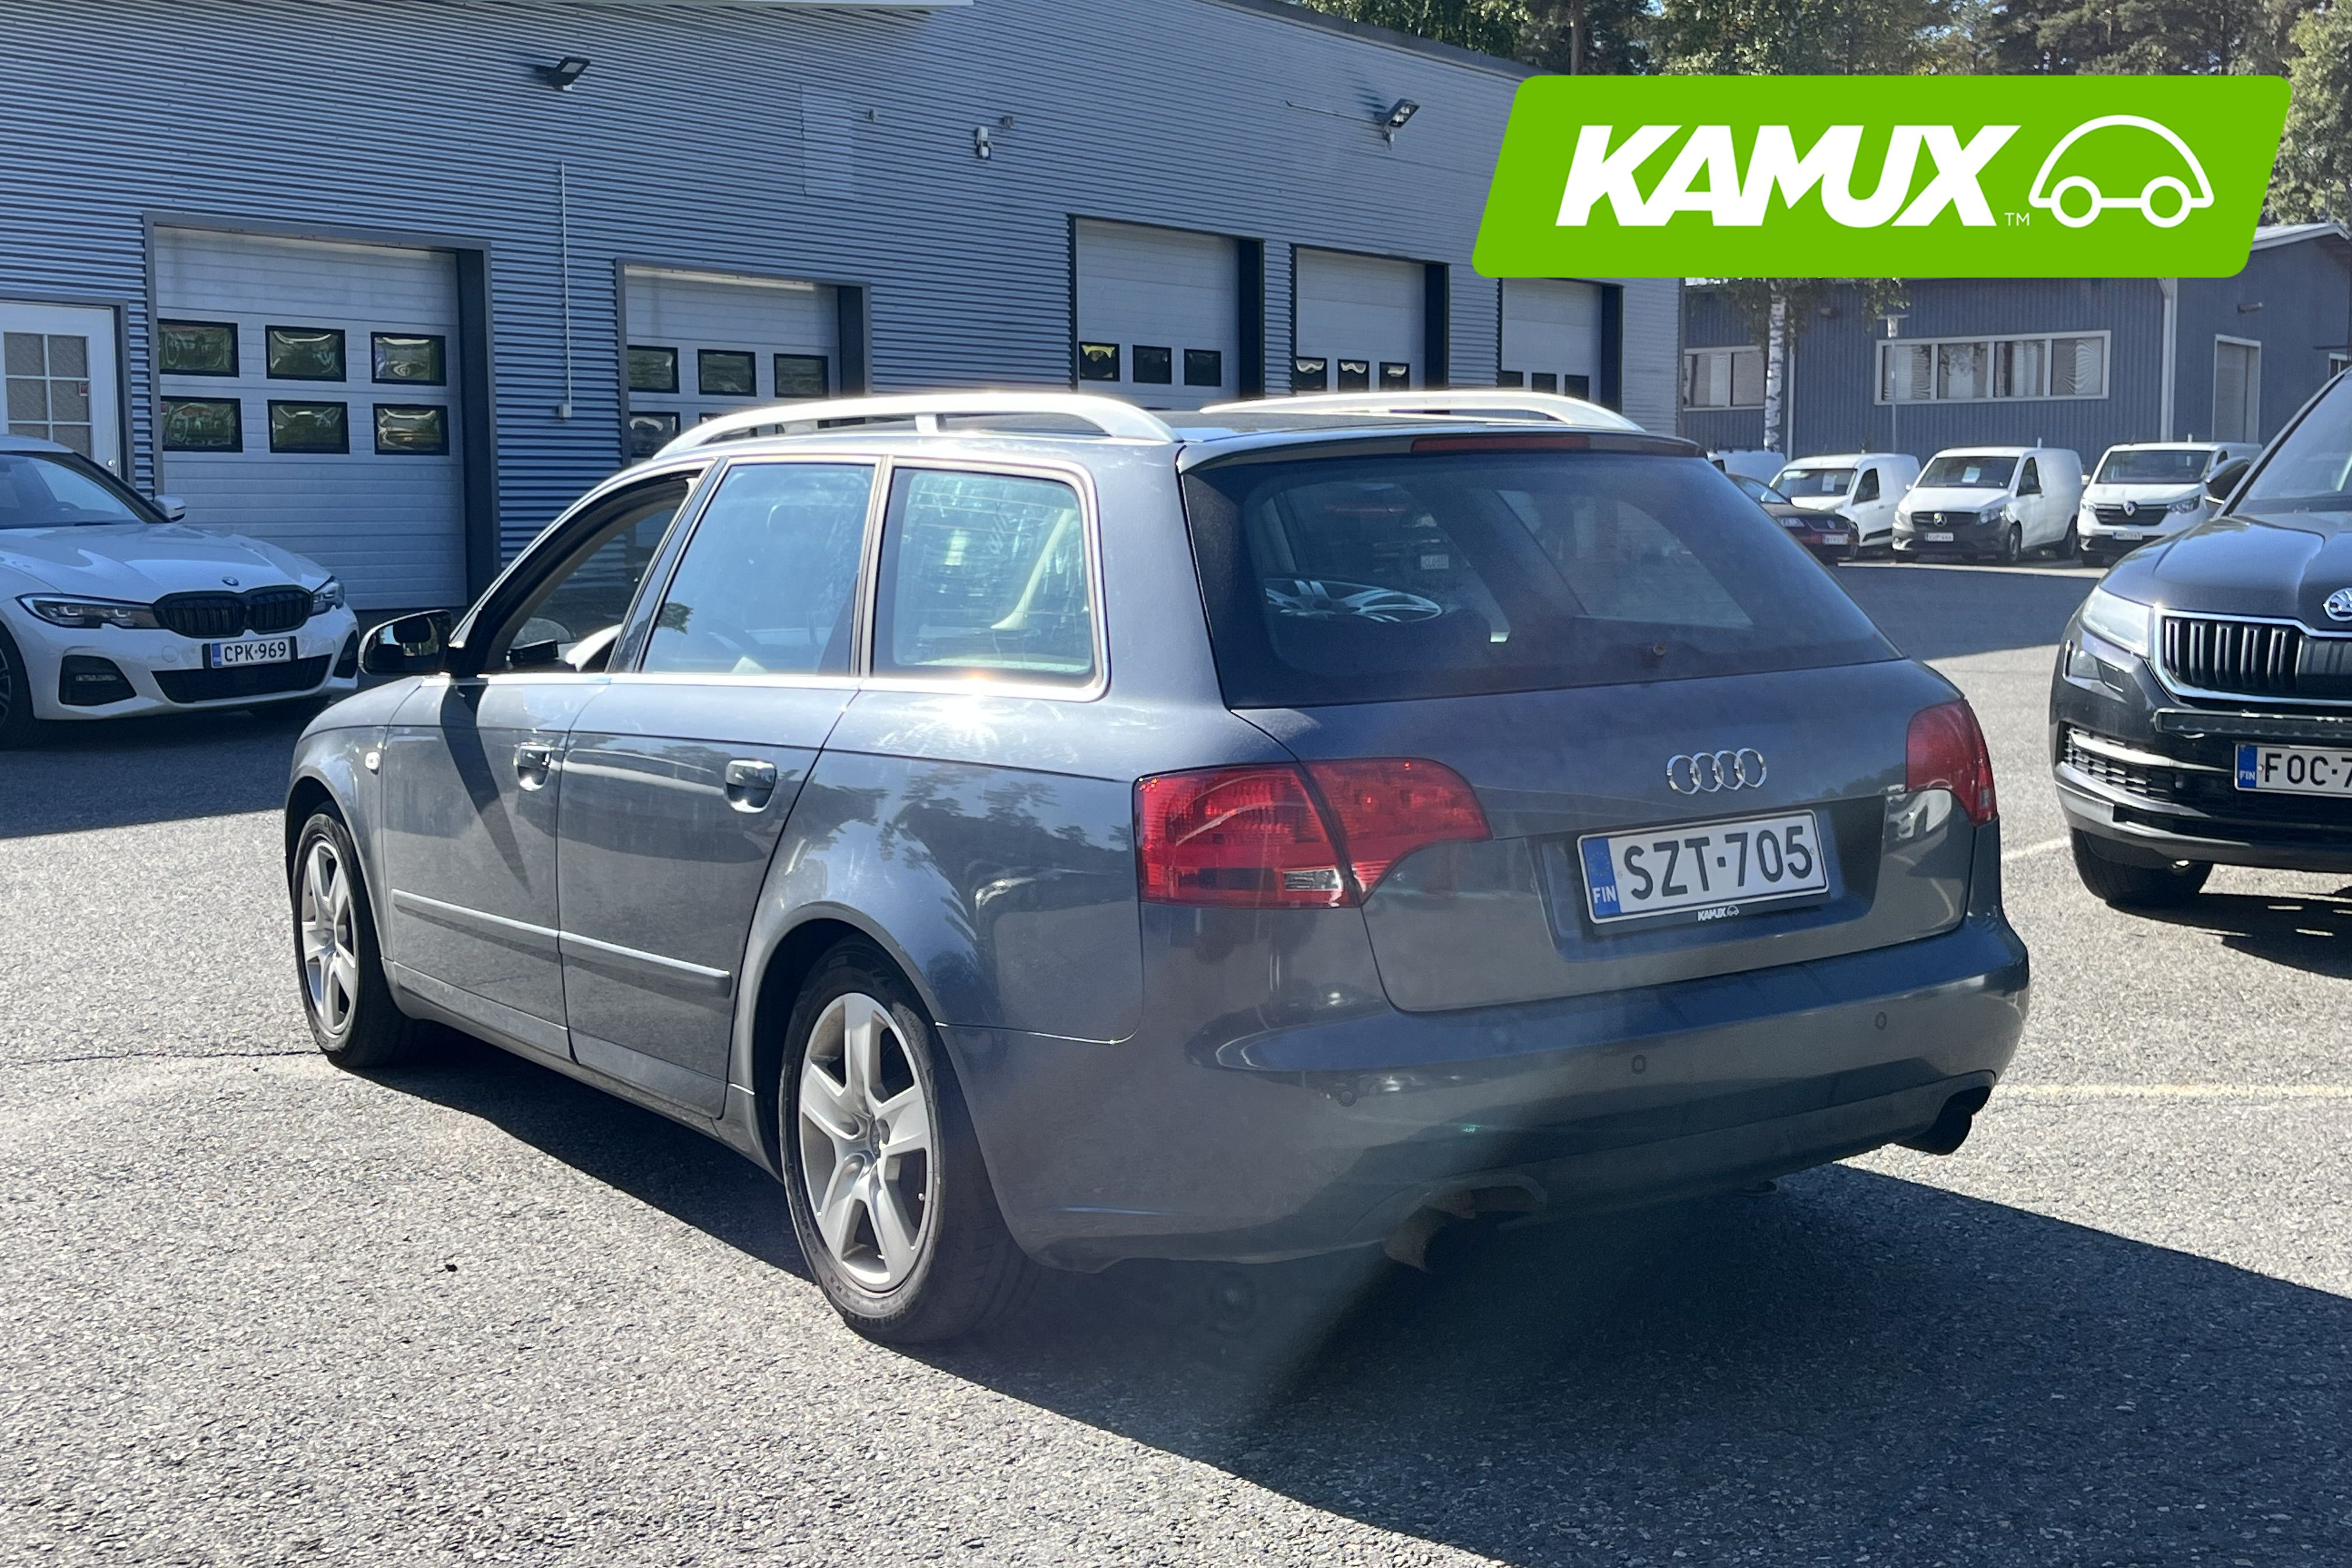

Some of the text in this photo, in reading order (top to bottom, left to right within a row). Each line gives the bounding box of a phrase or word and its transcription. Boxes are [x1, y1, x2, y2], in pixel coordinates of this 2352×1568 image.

[225, 642, 286, 662] CPK-969
[2239, 770, 2256, 780] FIN
[1624, 825, 1812, 900] SZT-705
[1592, 885, 1617, 904] FIN
[1698, 907, 1726, 921] KAMUX
